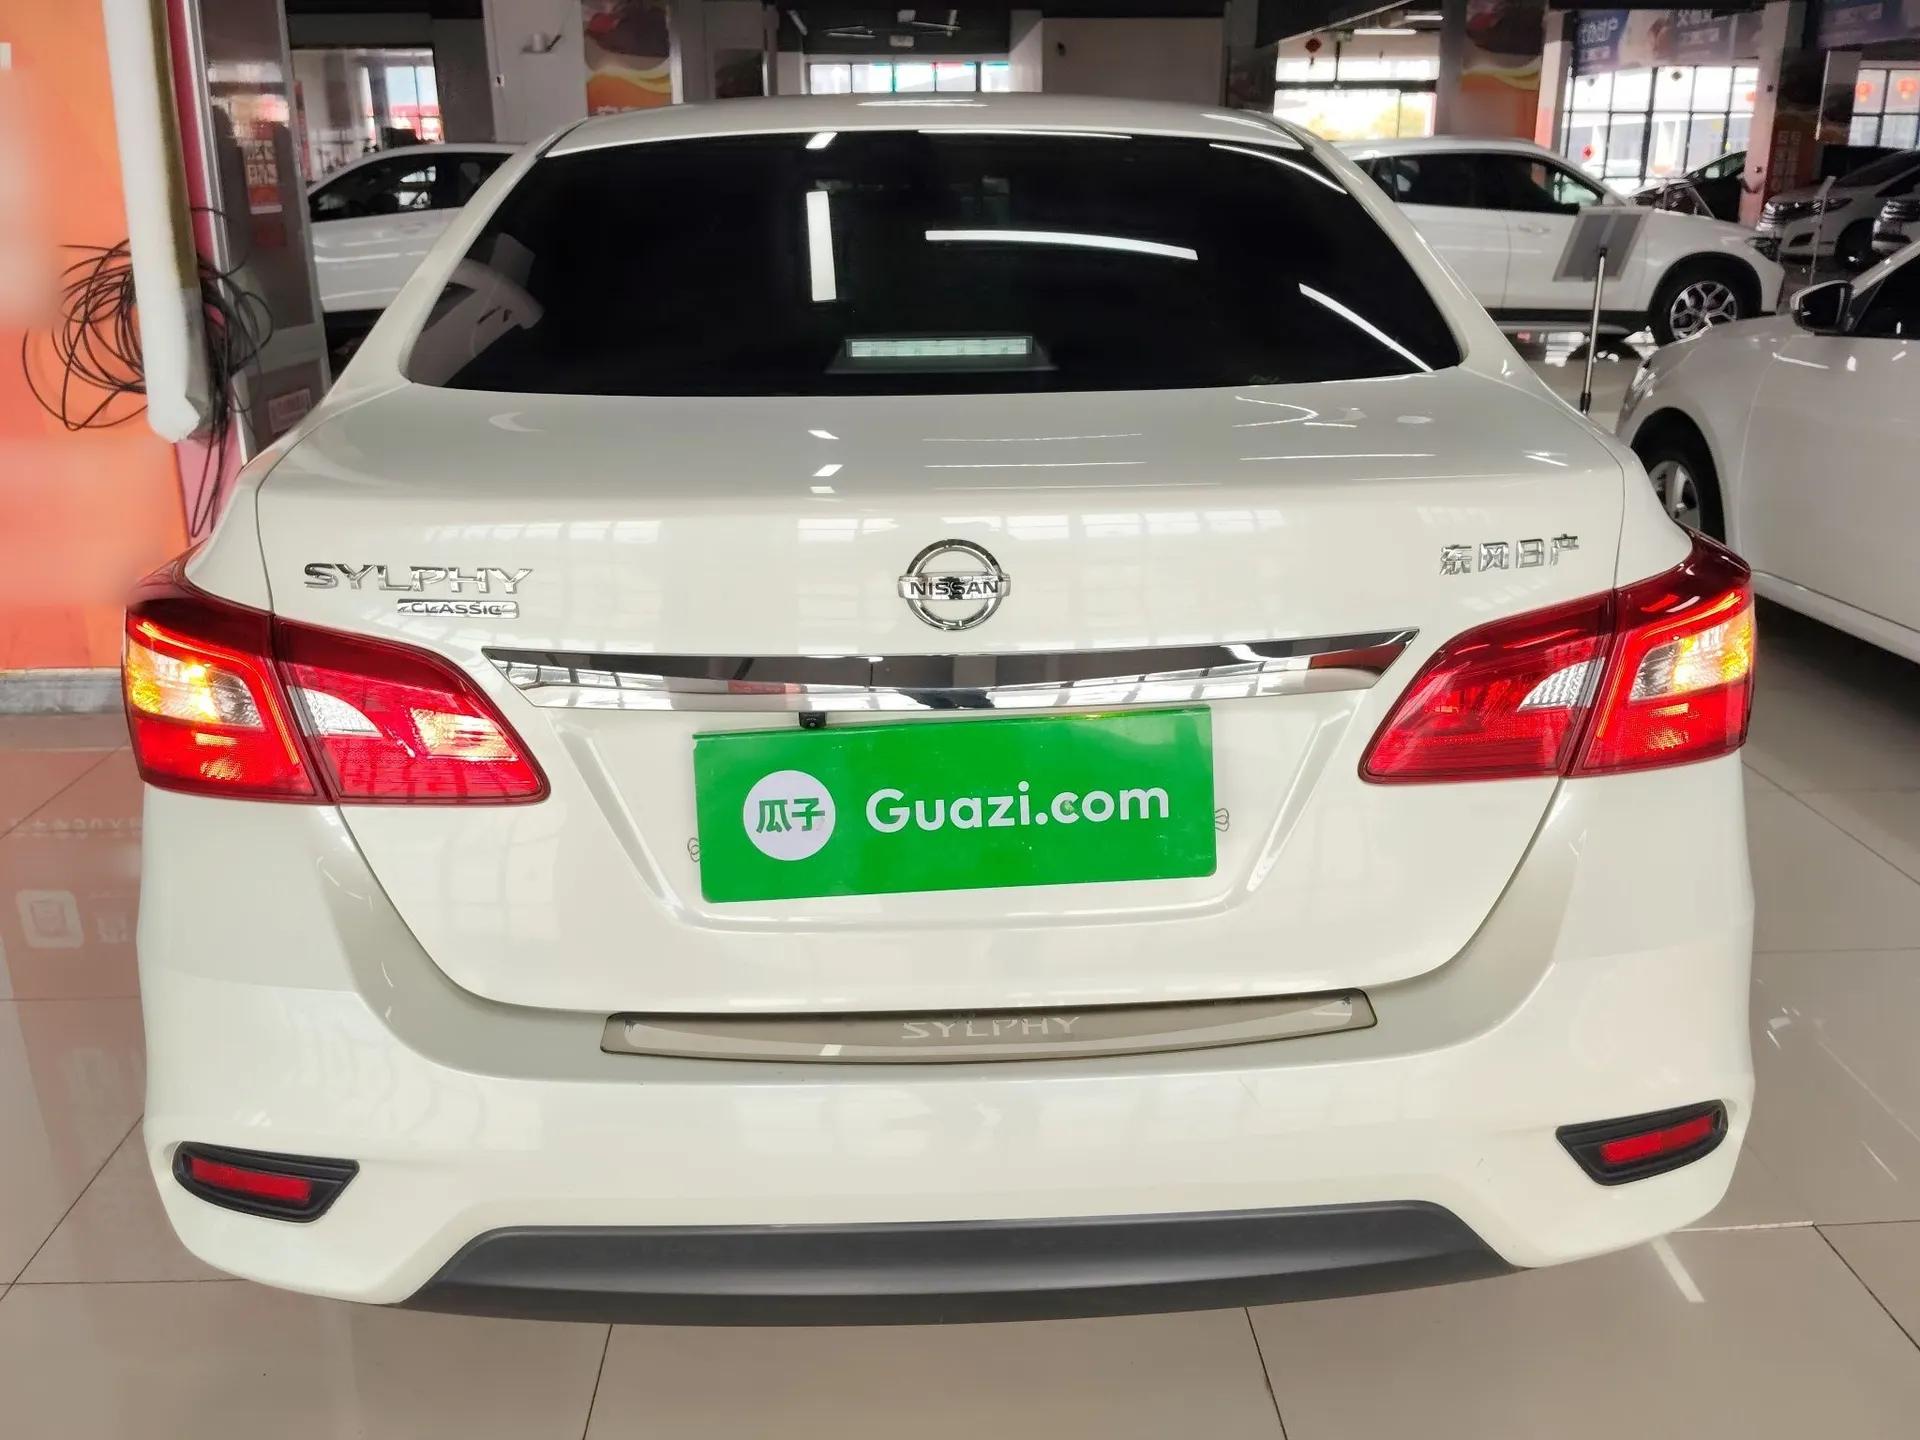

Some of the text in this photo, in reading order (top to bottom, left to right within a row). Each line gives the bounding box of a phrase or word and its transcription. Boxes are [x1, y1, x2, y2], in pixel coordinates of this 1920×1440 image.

[1439, 533, 1580, 576] 东风日产
[303, 562, 533, 594] SYLPHY
[910, 580, 999, 596] NISSAN
[411, 602, 503, 616] CLASSIC
[756, 780, 1170, 834] 瓜子 Guazi.com
[901, 1016, 1080, 1039] SYLPHY
